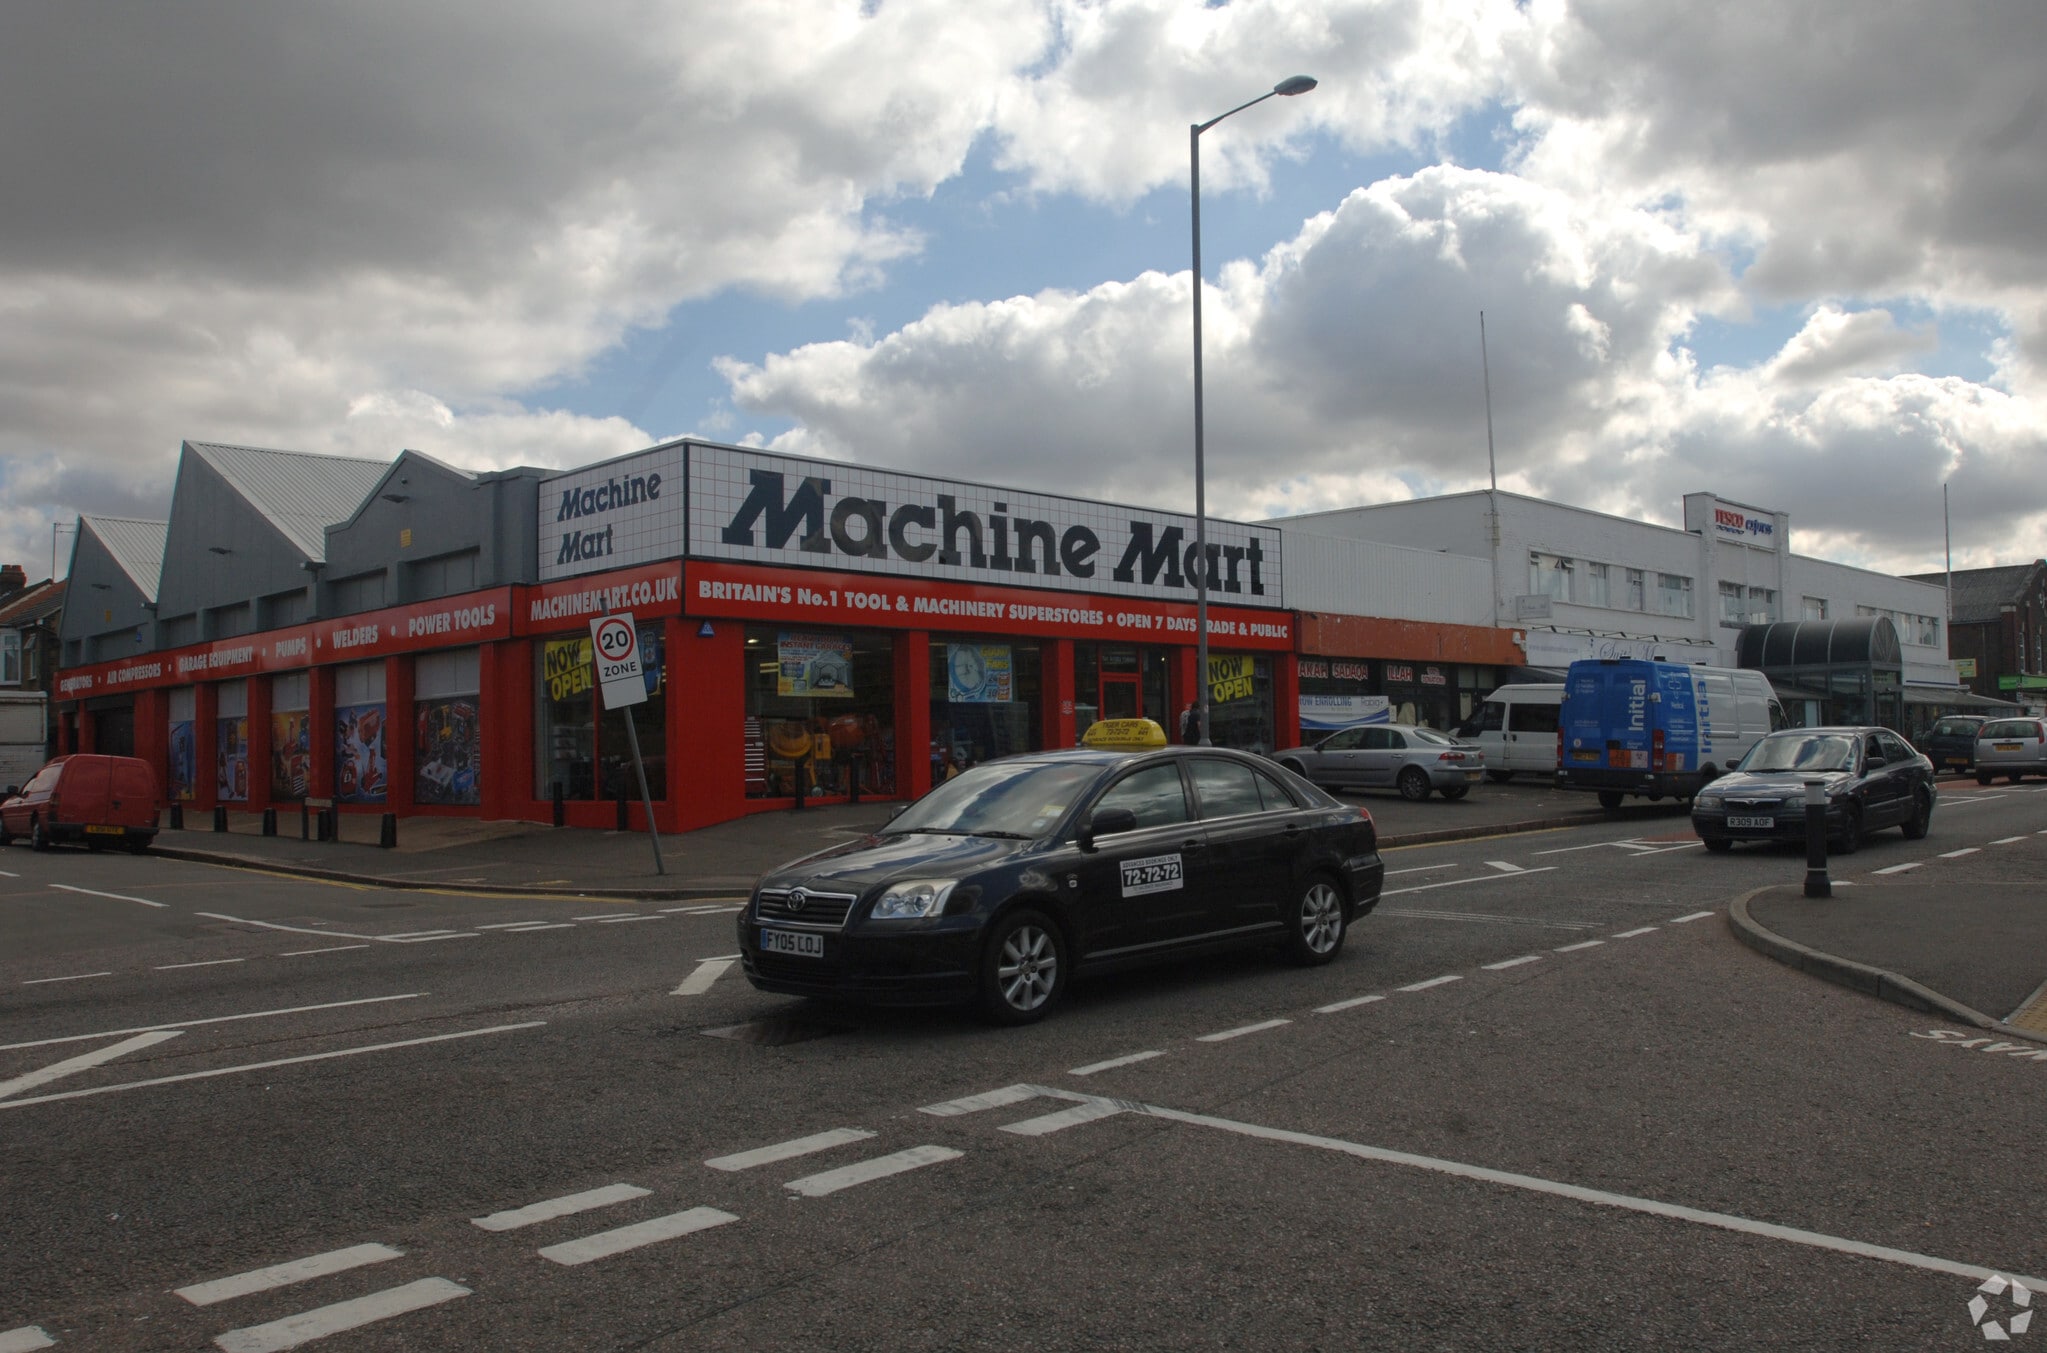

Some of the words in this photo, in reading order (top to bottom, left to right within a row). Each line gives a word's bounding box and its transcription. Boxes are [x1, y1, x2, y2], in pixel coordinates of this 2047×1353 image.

[557, 473, 662, 522] Machine
[1715, 508, 1744, 528] TESCO
[557, 523, 613, 565] Mart
[720, 468, 1101, 579] Machine
[1113, 520, 1264, 597] Mart
[530, 576, 678, 621] MACHINEMART.CO.UK
[698, 580, 792, 604] BRITAIN'S
[797, 587, 838, 607] No.1
[844, 591, 891, 611] TOOL
[895, 595, 910, 612] &
[913, 596, 1005, 618] MACHINERY
[1008, 603, 1104, 625] SUPERSTORES
[408, 612, 451, 637] POWER
[454, 603, 495, 631] TOOLS
[1116, 612, 1152, 630] OPEN
[1155, 615, 1164, 630] 7
[1166, 616, 1197, 632] DAYS
[1206, 619, 1236, 635] RADE
[1238, 622, 1249, 636] &
[1250, 623, 1288, 639] PUBLIC
[275, 637, 306, 659] PUMPS
[332, 624, 379, 649] WELDERS
[602, 630, 629, 650] 20
[179, 653, 208, 673] GARAGE
[209, 645, 253, 668] EQUIPMENT
[546, 640, 580, 677] NOW
[603, 661, 637, 677] ZONE
[1208, 656, 1243, 682] NOW
[1298, 660, 1329, 679] AKAH
[106, 671, 117, 685] AIR
[118, 663, 161, 684] COMPRESSORS
[551, 664, 593, 702] OPEN
[1213, 676, 1254, 703] OPEN
[1315, 695, 1352, 707] ENROLLING
[1627, 679, 1646, 732] Initial
[1729, 817, 1752, 827] R309
[766, 930, 795, 951] FY05
